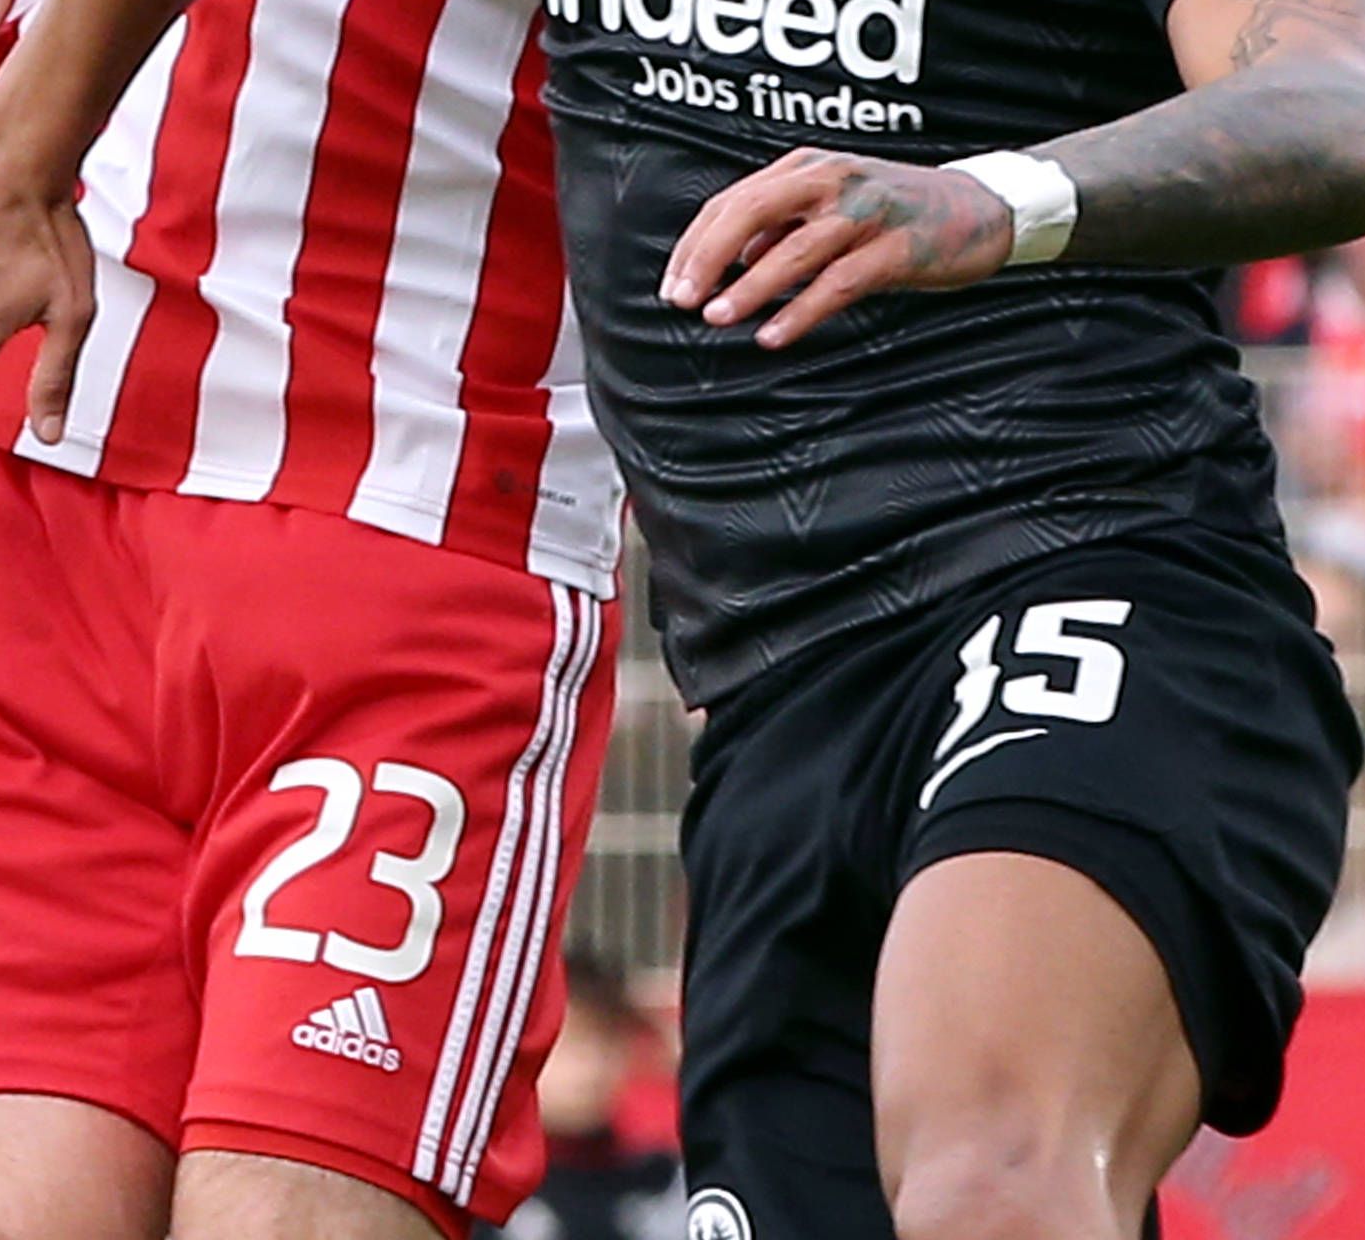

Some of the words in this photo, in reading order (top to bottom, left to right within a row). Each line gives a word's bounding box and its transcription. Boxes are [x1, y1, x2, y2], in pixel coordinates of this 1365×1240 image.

[633, 56, 738, 112] Jobs
[746, 73, 924, 132] finden
[235, 758, 465, 983] 23
[292, 1024, 401, 1072] adidas
